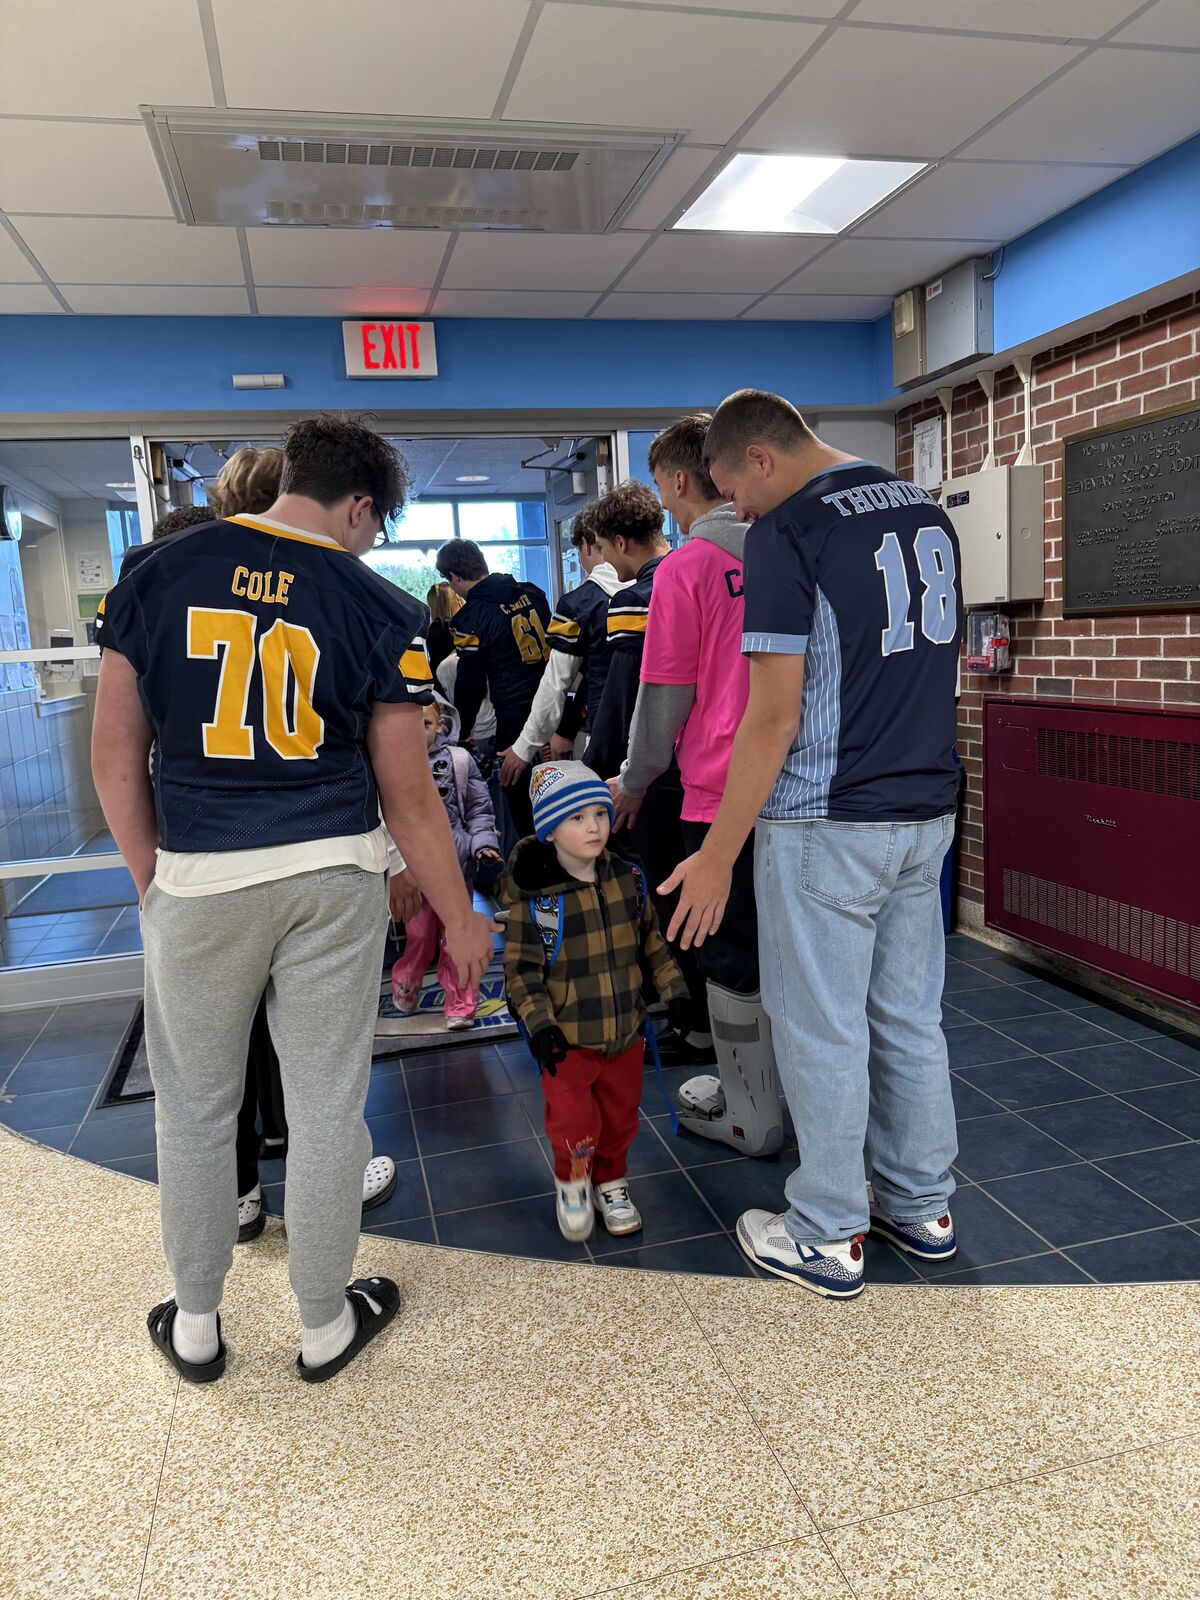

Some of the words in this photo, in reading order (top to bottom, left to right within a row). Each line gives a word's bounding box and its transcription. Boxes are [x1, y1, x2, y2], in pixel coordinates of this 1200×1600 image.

[361, 323, 421, 370] EXIT
[1149, 440, 1183, 460] FISHER
[1121, 463, 1164, 483] SCHOOL
[821, 481, 938, 517] THUNDE
[231, 565, 295, 606] COLE
[874, 526, 957, 657] 18
[511, 608, 551, 665] 61
[187, 606, 325, 760] 70
